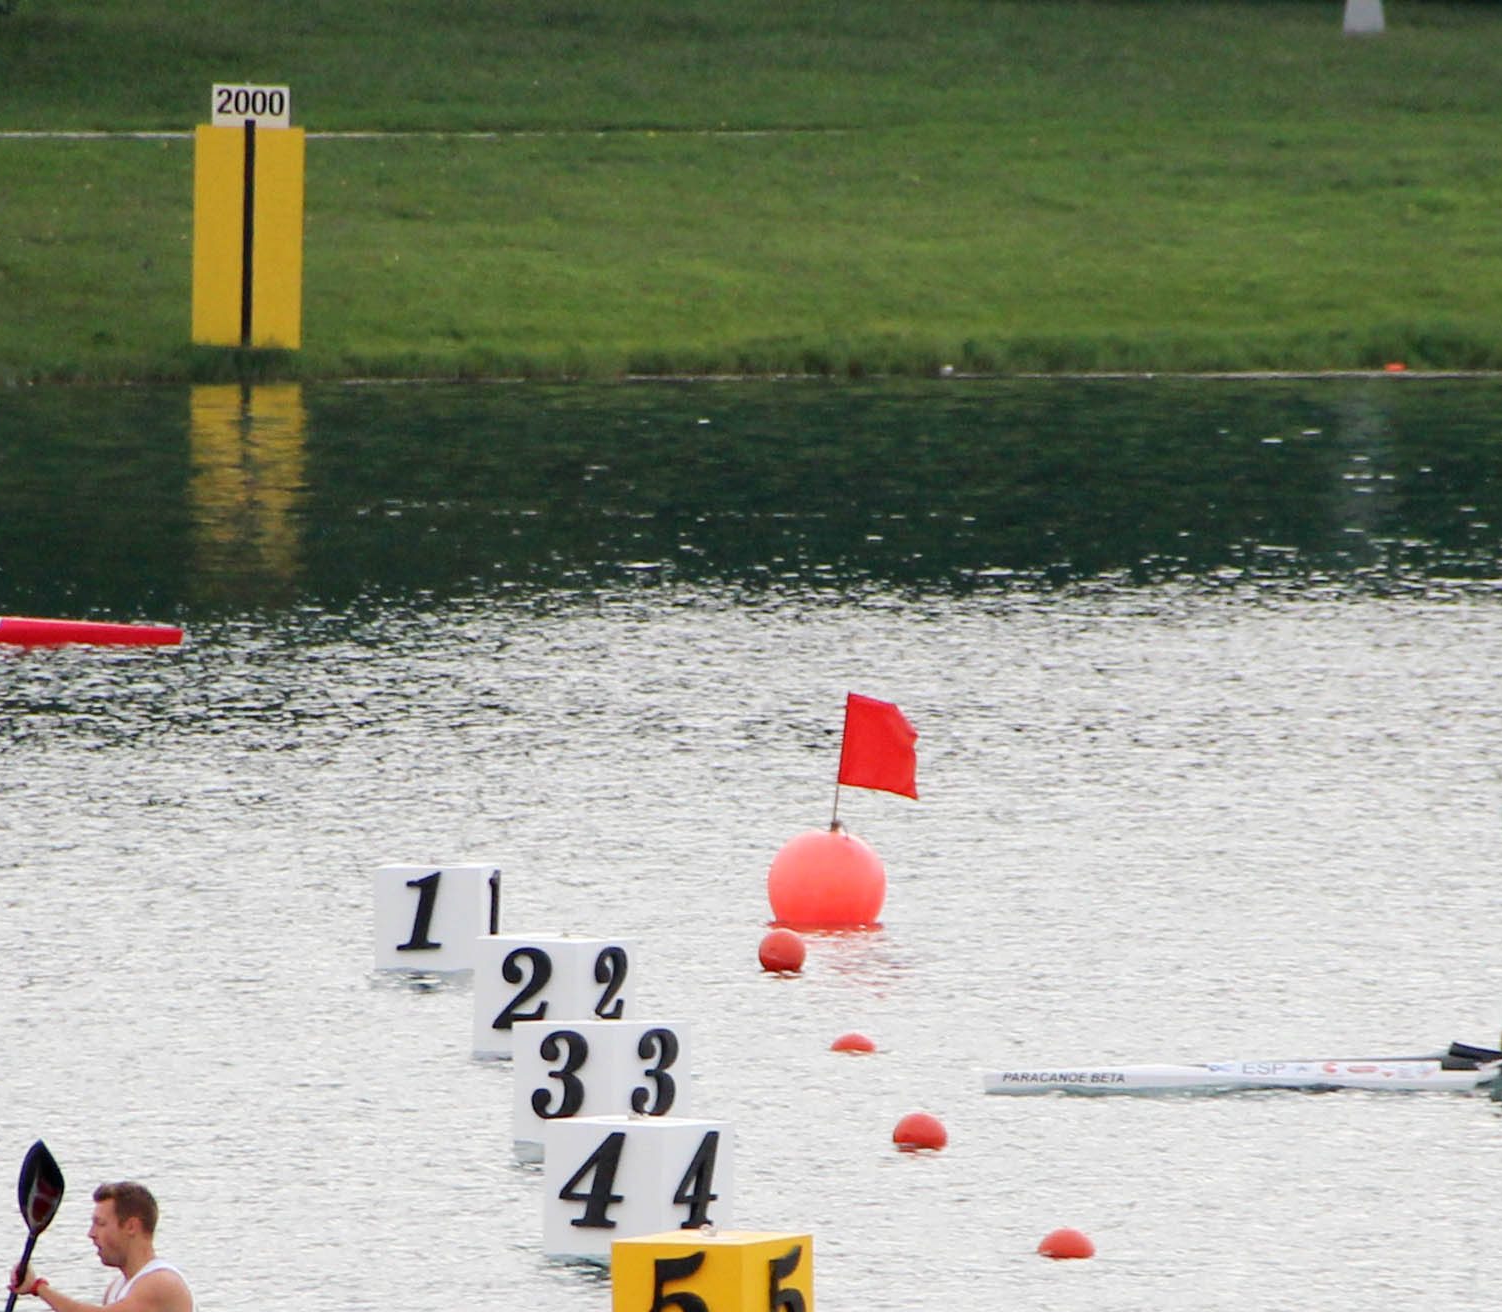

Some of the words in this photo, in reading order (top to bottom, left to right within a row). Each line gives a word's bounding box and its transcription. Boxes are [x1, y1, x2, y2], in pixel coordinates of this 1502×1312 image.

[217, 89, 284, 116] 2000
[397, 871, 442, 951] 1
[489, 869, 502, 935] 1
[492, 946, 553, 1030] 2
[595, 946, 628, 1020] 2
[531, 1030, 589, 1119] 3
[631, 1028, 679, 1116] 3
[1003, 1072, 1089, 1083] PARACANOE
[1091, 1072, 1126, 1083] BETA
[1242, 1063, 1286, 1075] ESP
[559, 1132, 626, 1229] 4
[673, 1131, 720, 1229] 4
